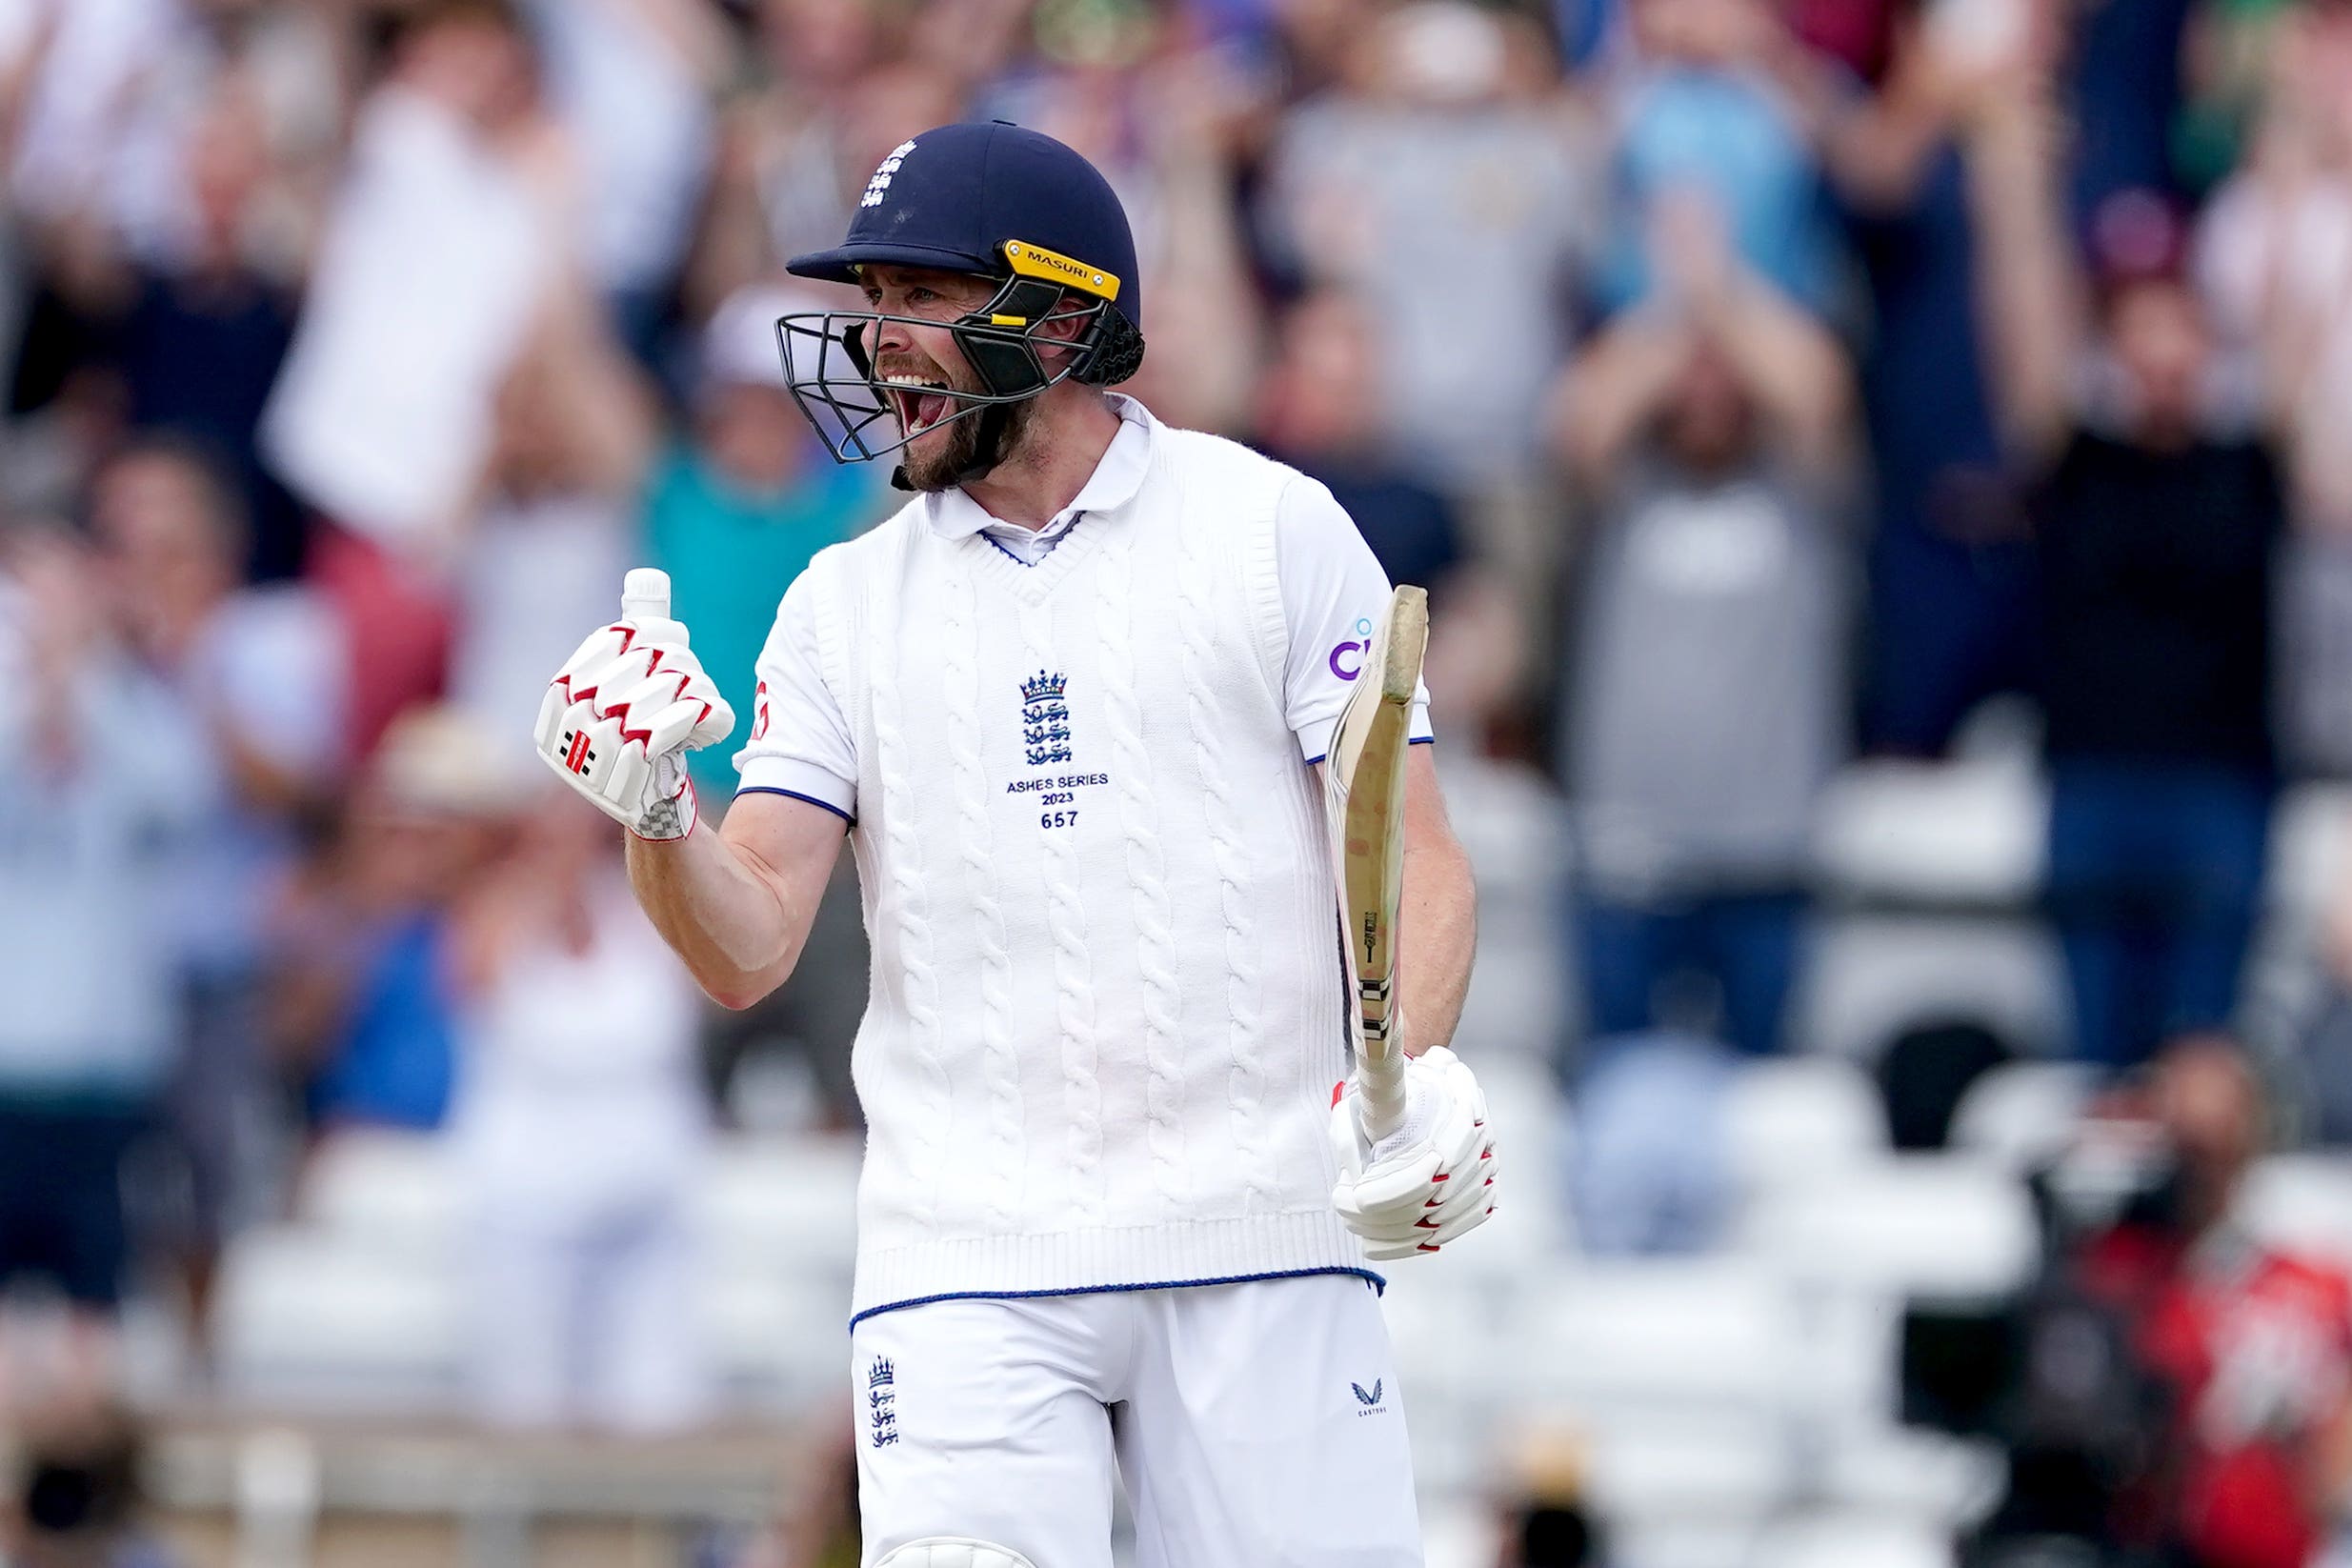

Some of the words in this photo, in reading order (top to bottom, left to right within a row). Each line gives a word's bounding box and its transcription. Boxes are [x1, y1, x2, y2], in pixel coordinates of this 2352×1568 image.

[1028, 251, 1088, 278] MASURI
[1007, 778, 1054, 794] ASHES
[1057, 773, 1109, 789] SERIES
[1042, 792, 1074, 806] 2023
[1041, 811, 1078, 829] 657
